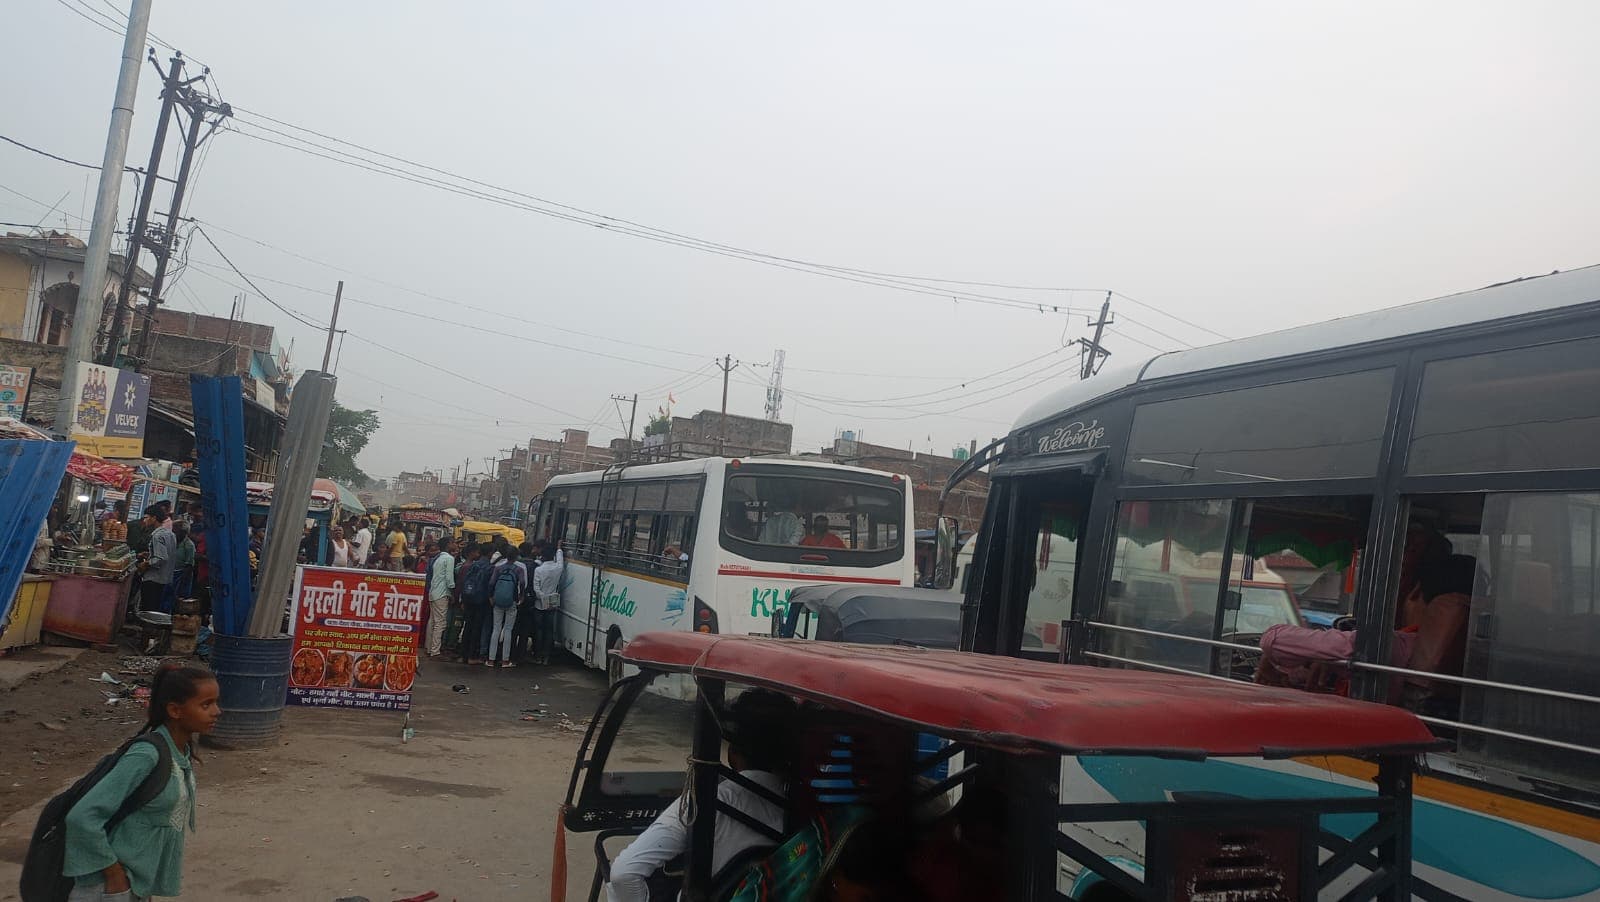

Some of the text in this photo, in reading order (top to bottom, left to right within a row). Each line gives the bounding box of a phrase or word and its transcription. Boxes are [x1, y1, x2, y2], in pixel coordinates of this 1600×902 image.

[115, 414, 139, 428] VELVEX
[1038, 419, 1105, 454] Welcome
[303, 580, 424, 624] मुरली मीट होटल
